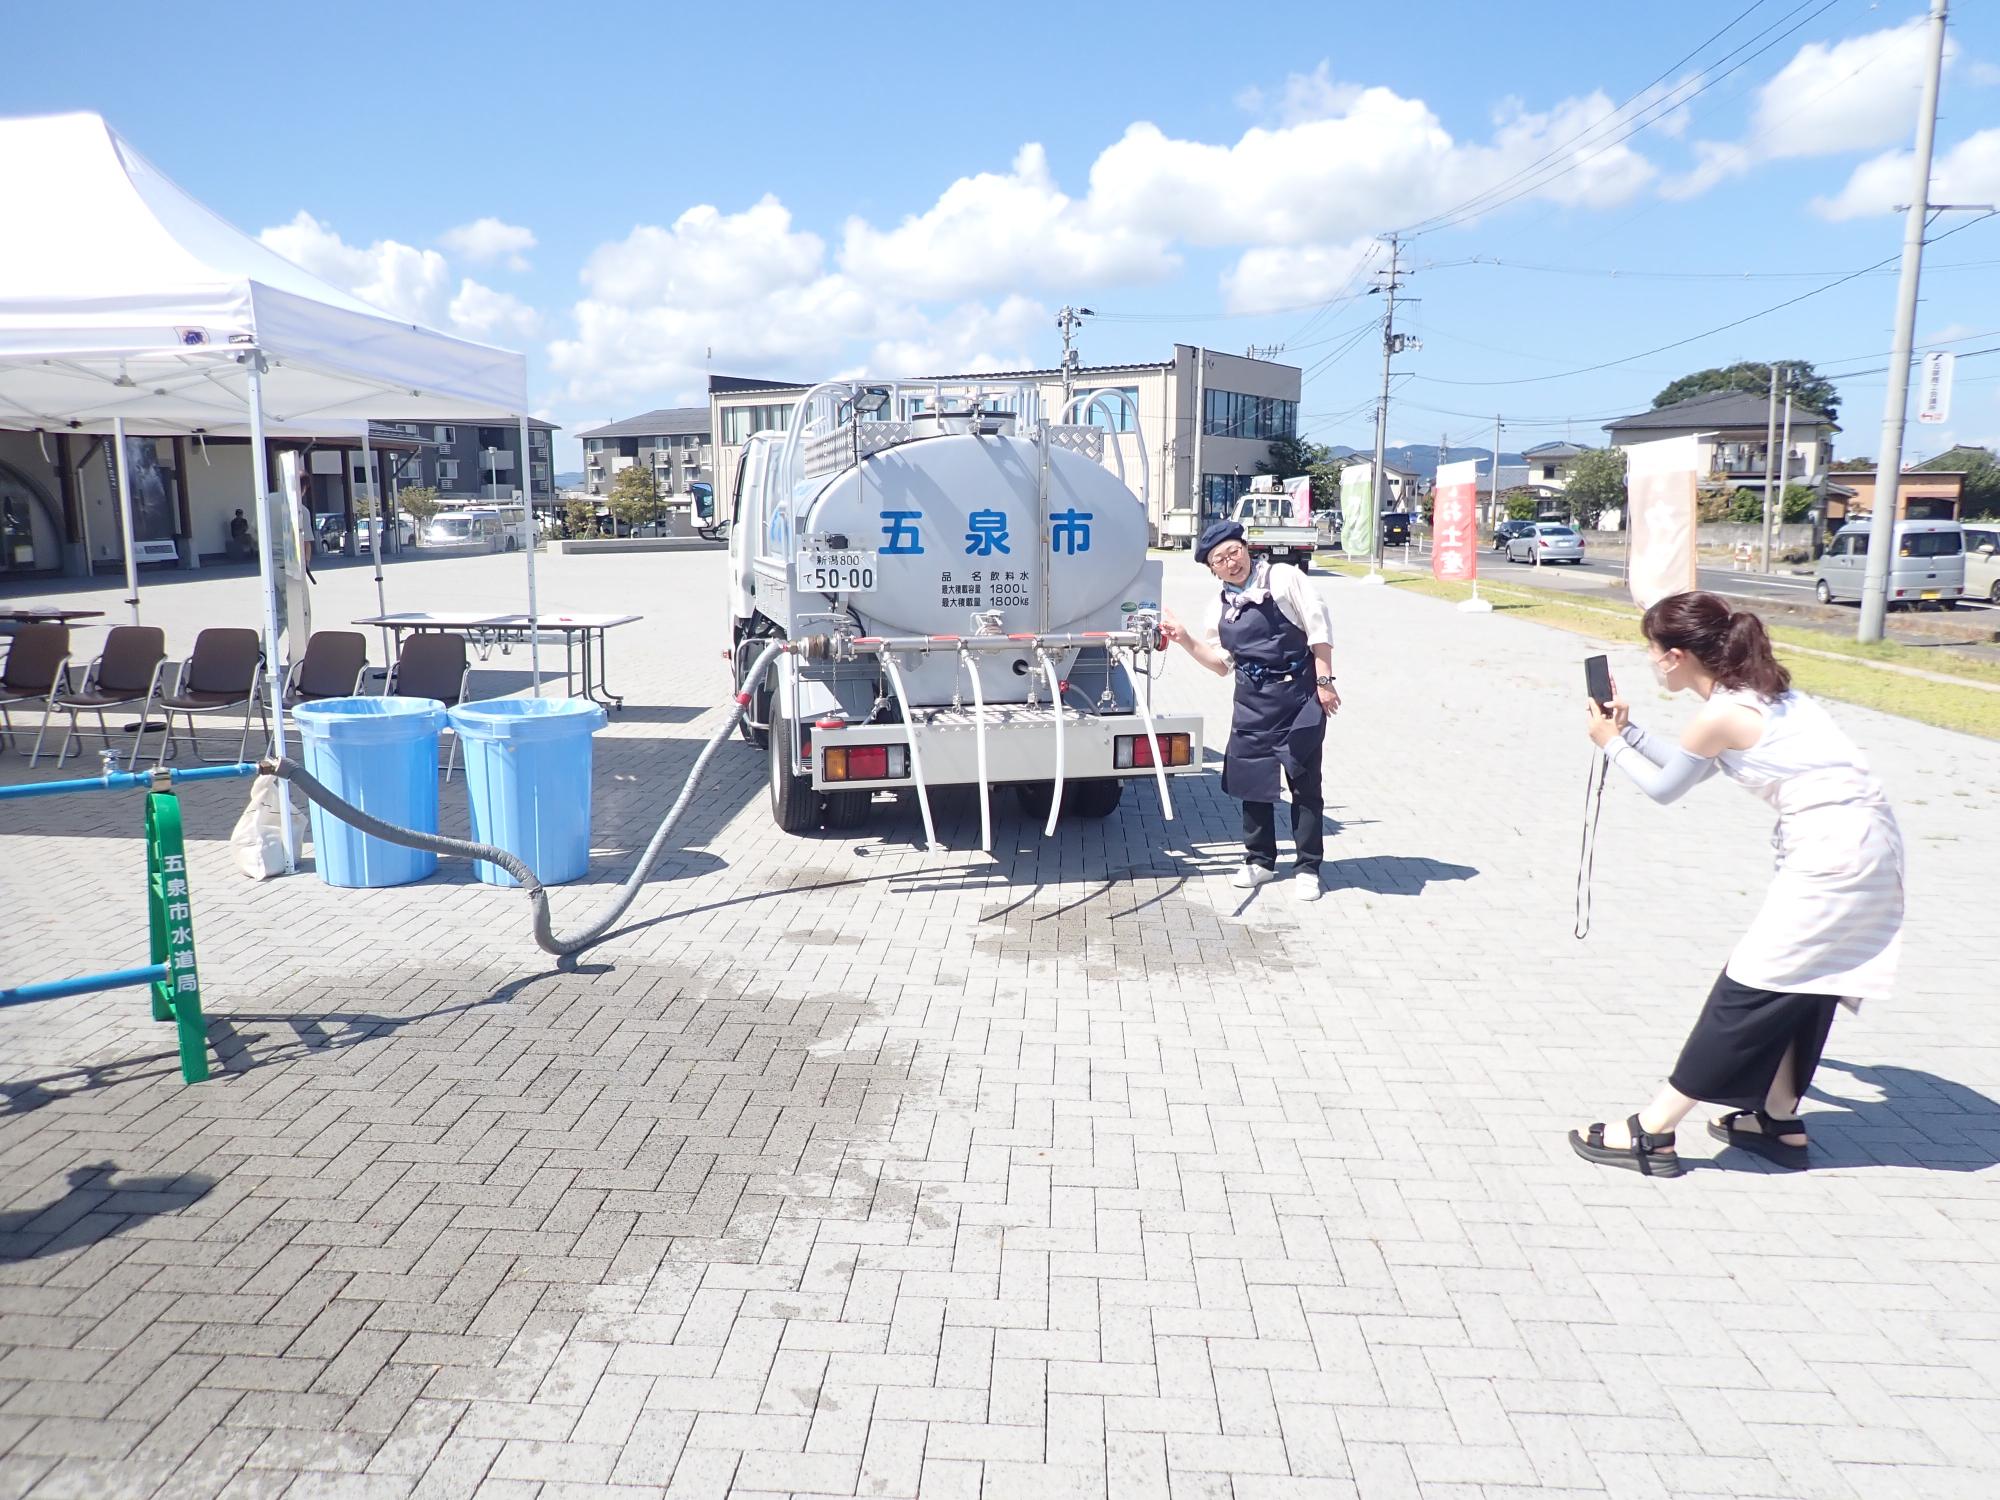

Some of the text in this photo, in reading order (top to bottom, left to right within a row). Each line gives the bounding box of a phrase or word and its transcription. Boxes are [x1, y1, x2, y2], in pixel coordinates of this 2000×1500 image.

[878, 508, 1094, 556] 五泉市
[816, 568, 873, 588] 50-00
[990, 571, 1029, 581] 飲料水
[941, 597, 981, 607] 最大積載量
[164, 855, 197, 993] 五泉市水道局
